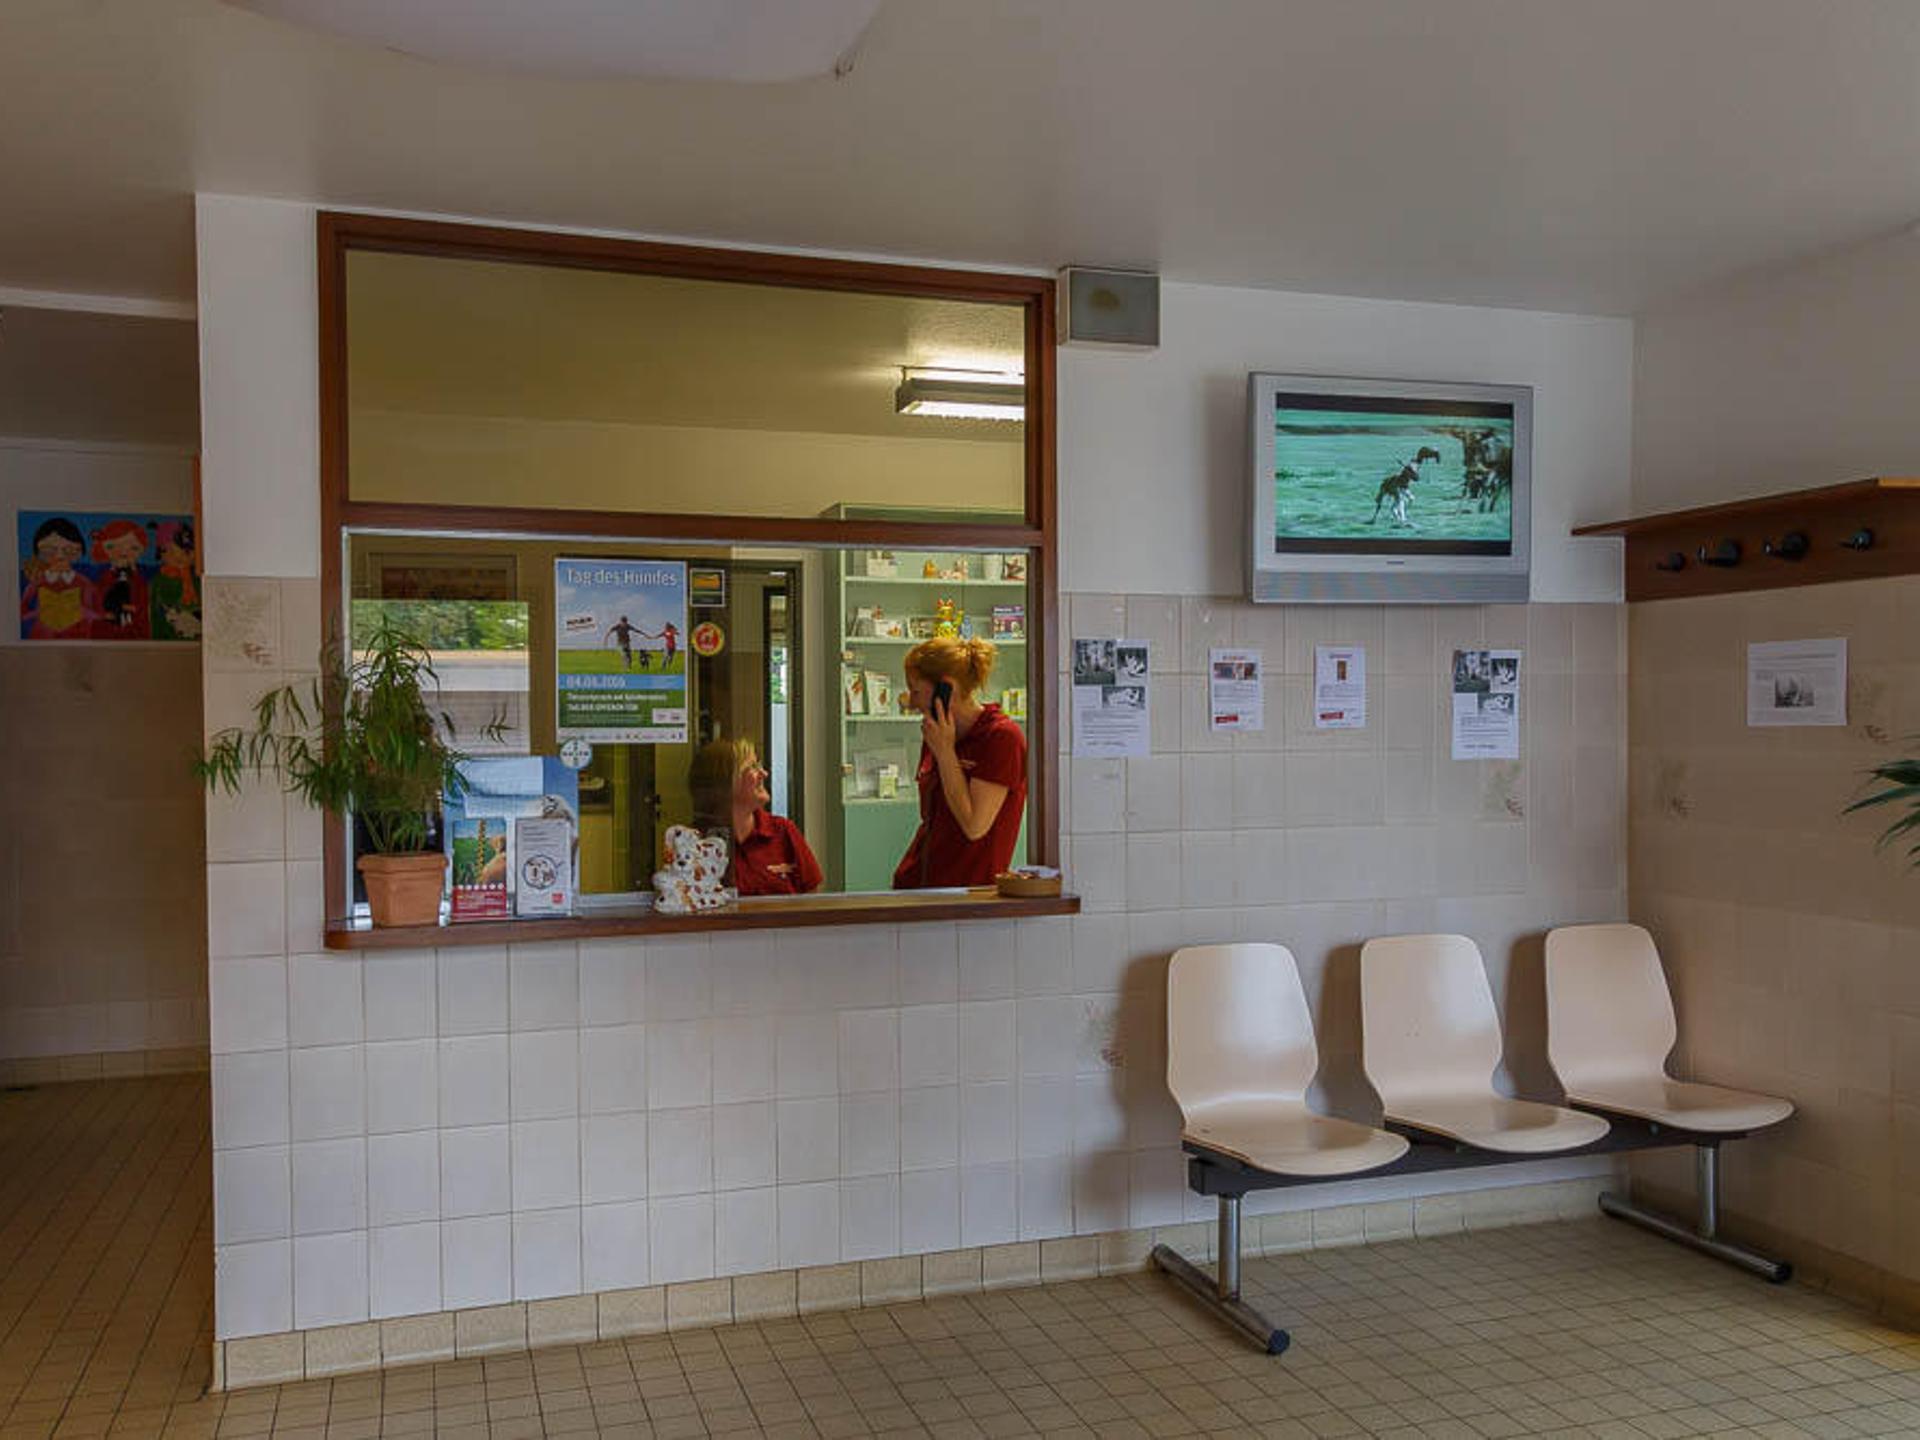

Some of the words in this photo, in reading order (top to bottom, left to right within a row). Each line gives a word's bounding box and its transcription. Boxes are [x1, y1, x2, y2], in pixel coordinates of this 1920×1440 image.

[567, 568, 591, 586] Tag
[595, 569, 620, 584] des
[624, 569, 677, 586] Hundes
